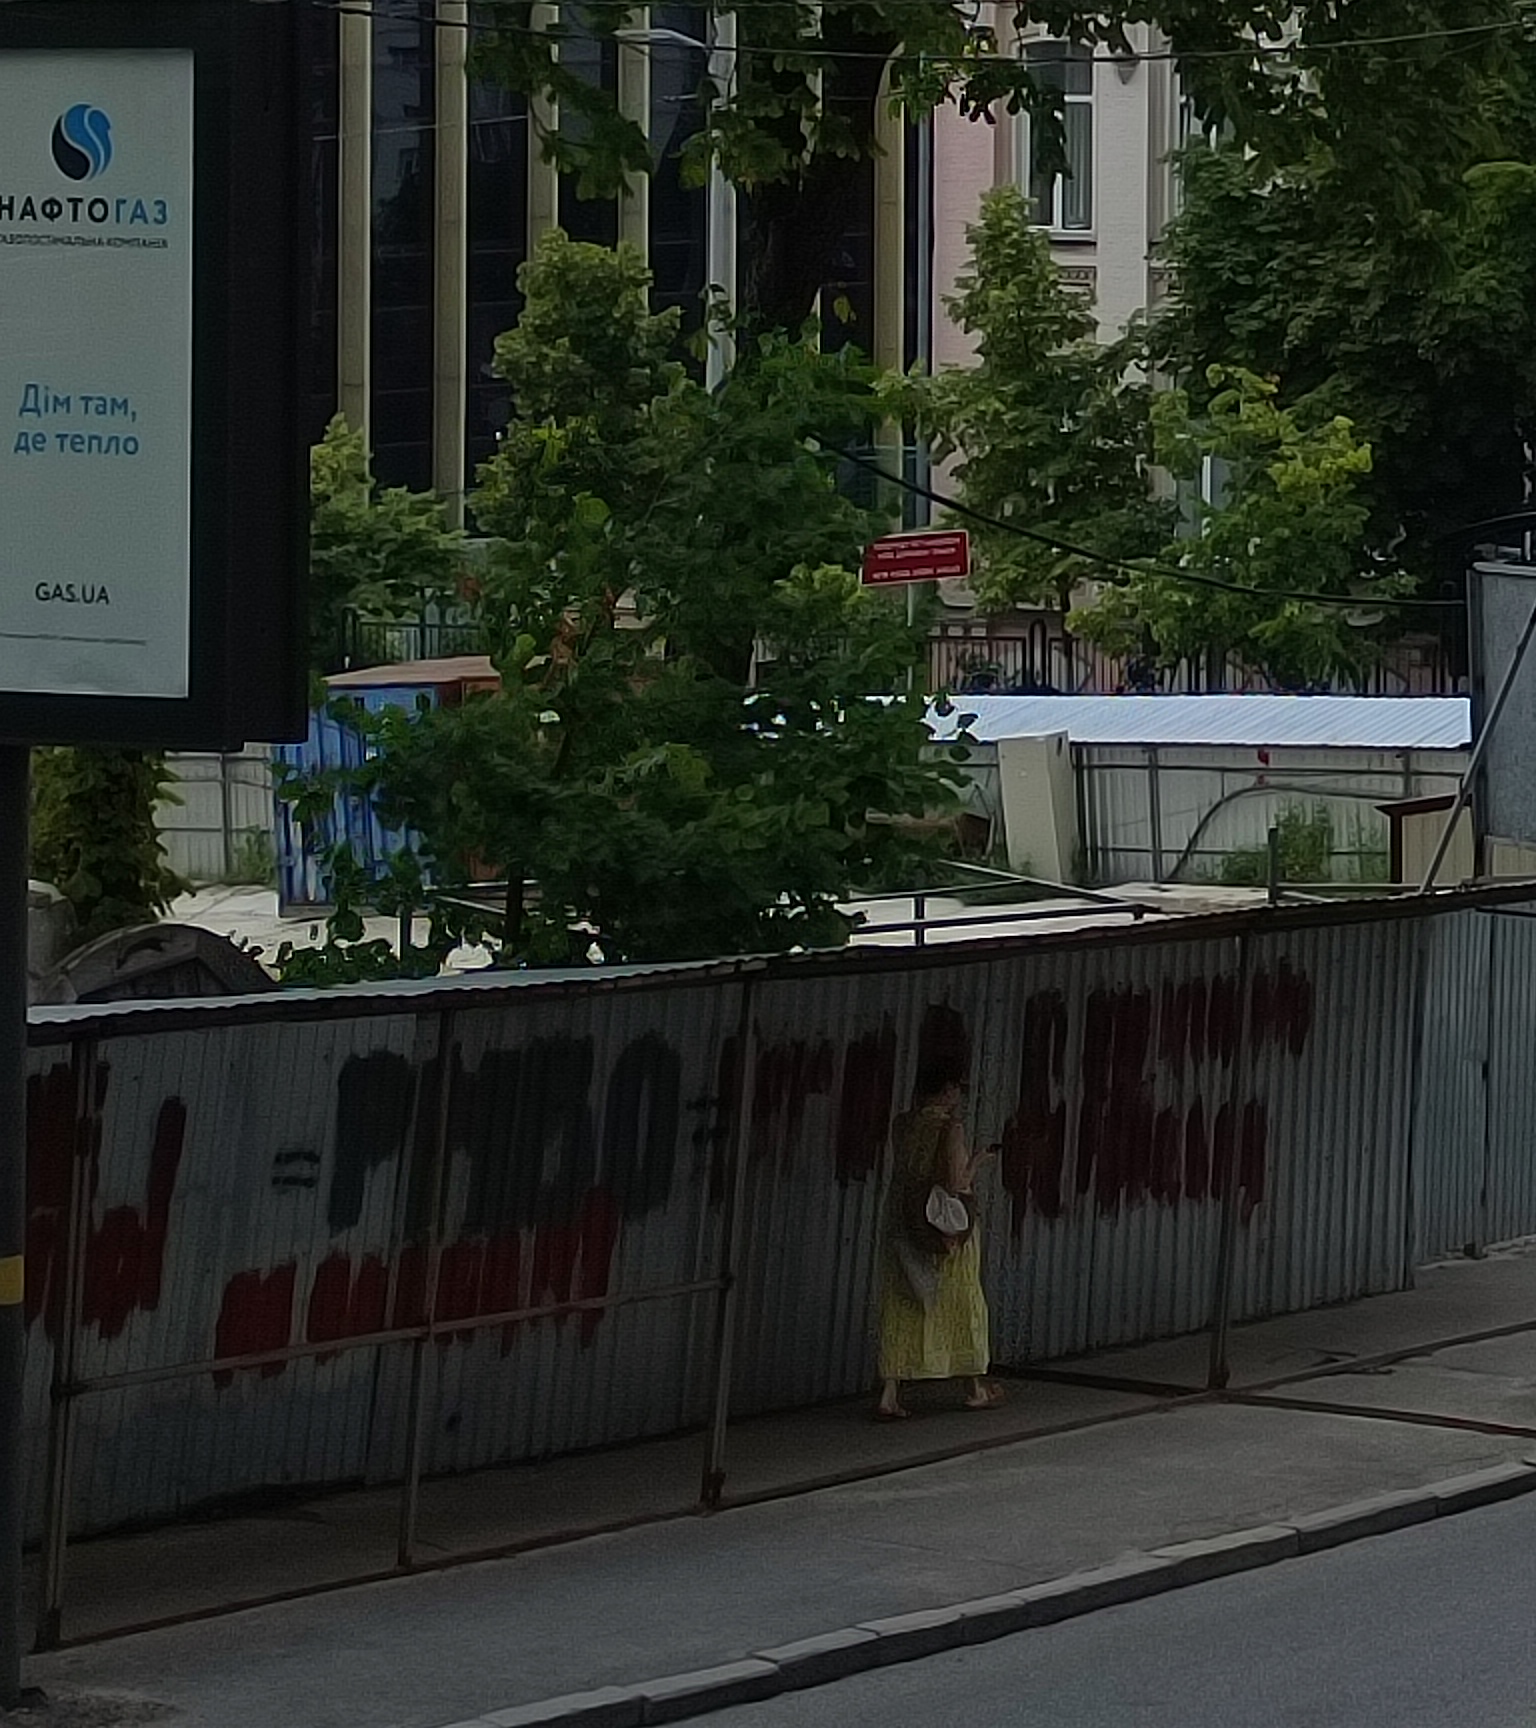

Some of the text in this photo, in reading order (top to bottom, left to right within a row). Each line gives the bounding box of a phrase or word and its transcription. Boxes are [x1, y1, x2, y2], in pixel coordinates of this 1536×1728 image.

[0, 196, 168, 226] НАФТОГАЗ
[18, 382, 138, 422] Дім там,
[13, 430, 139, 457] де тепло
[34, 581, 110, 605] GAS.UA
